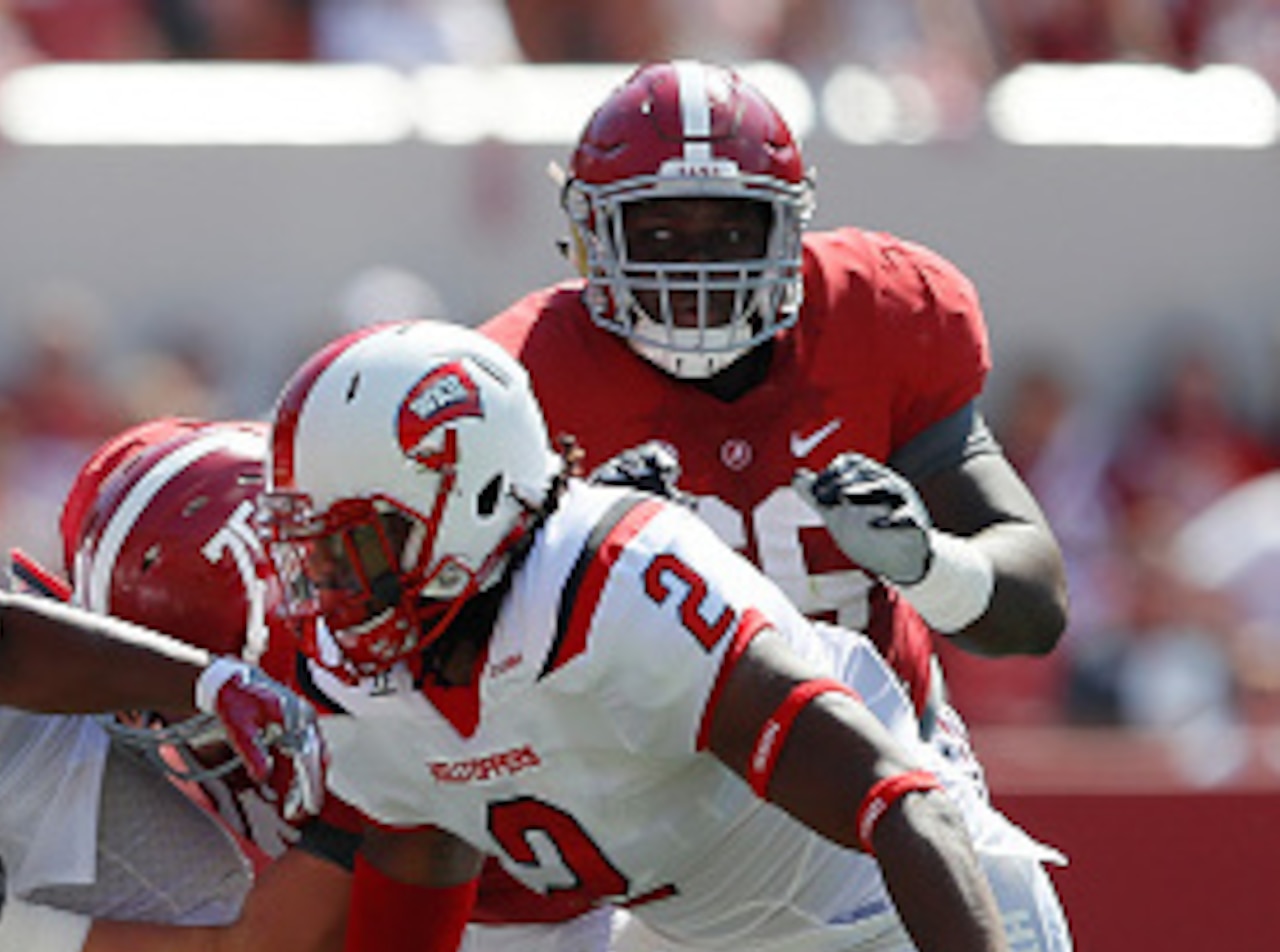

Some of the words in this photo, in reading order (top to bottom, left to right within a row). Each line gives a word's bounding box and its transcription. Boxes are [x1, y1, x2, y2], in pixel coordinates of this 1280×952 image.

[644, 551, 735, 653] 2
[690, 486, 876, 630] 6
[487, 795, 681, 909] 2
